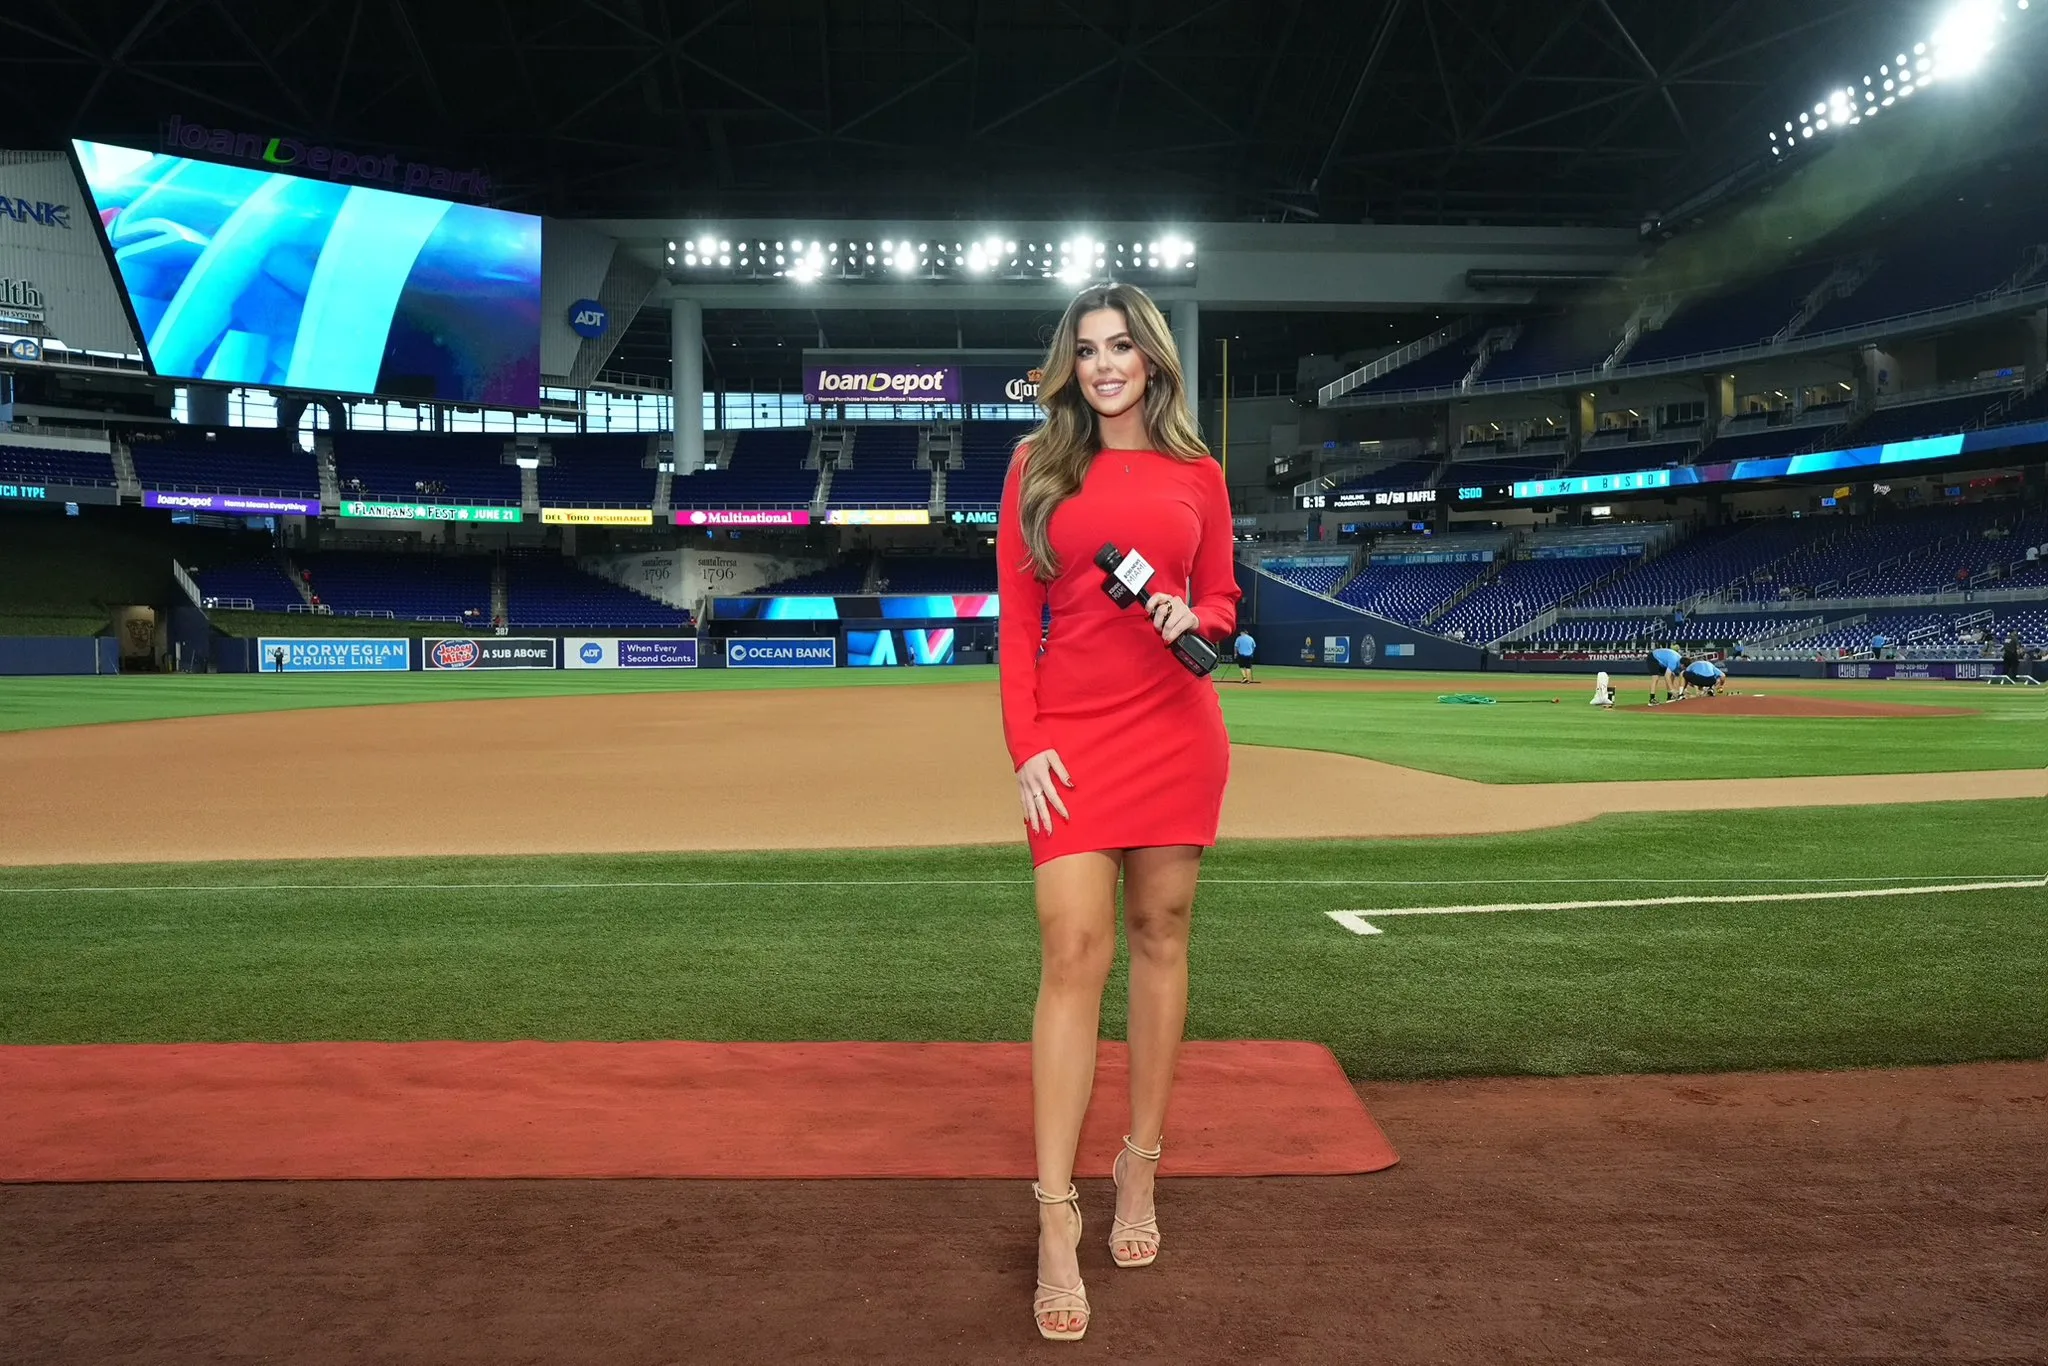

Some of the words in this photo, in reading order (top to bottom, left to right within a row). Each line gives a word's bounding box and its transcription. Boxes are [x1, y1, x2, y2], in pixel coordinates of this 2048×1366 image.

[167, 114, 399, 181] loanDepot
[403, 162, 492, 197] park
[11, 311, 40, 320] SYSTEM
[574, 310, 605, 326] ADT
[14, 342, 36, 357] 42
[818, 370, 945, 395] loanDepot
[1004, 378, 1040, 402] Cor
[20, 486, 45, 499] TYPE
[1375, 491, 1405, 505] 50/50
[1406, 490, 1436, 503] RAFFLE
[1458, 487, 1482, 500] $500
[157, 494, 212, 508] loanDepot
[224, 499, 245, 508] Home
[246, 501, 269, 509] Means
[269, 501, 307, 512] Everything
[1303, 496, 1326, 508] 6:15
[428, 506, 456, 520] FEST
[474, 509, 499, 519] JUNE
[503, 510, 513, 519] 21
[564, 512, 590, 521] TORO
[708, 512, 793, 523] Multinational
[965, 512, 997, 523] AMG
[1405, 555, 1425, 564] LEARN
[1427, 554, 1443, 563] MORE
[1445, 554, 1453, 562] AT
[293, 644, 403, 656] NORWEGIAN
[437, 643, 473, 656] Jersey
[482, 649, 490, 659] A
[492, 649, 511, 659] SUB
[514, 648, 547, 658] ABOVE
[583, 650, 600, 658] ADT
[627, 643, 652, 652] When
[654, 643, 677, 654] Every
[749, 648, 793, 658] OCEAN
[796, 647, 831, 658] BANK
[293, 656, 345, 665] CRUISE
[351, 656, 383, 665] LINE
[627, 654, 658, 663] Second
[661, 653, 695, 663] Counts.
